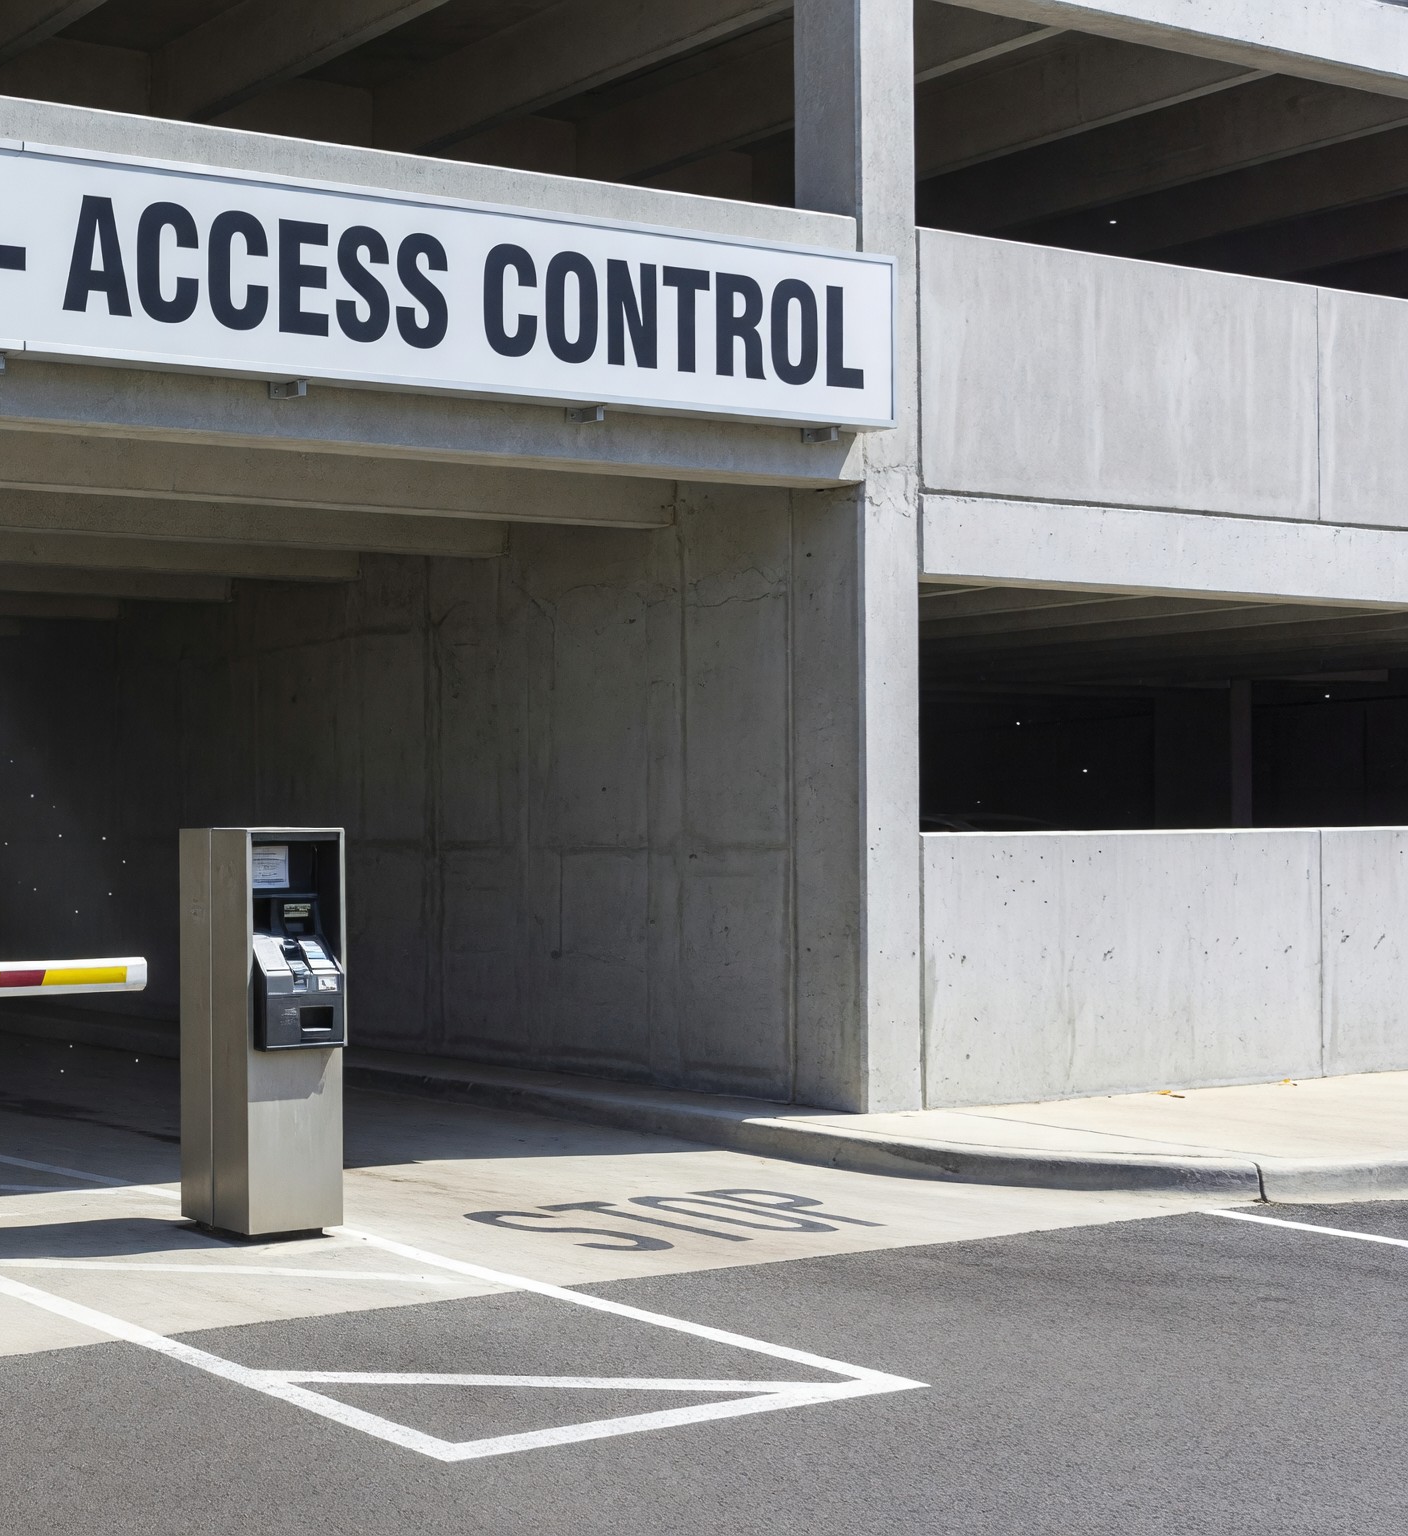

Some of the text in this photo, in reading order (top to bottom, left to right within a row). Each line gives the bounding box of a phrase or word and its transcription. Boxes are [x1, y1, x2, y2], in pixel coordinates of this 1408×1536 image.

[62, 194, 449, 349] ACCESS
[483, 243, 864, 390] CONTROL
[463, 1188, 887, 1252] STOP
